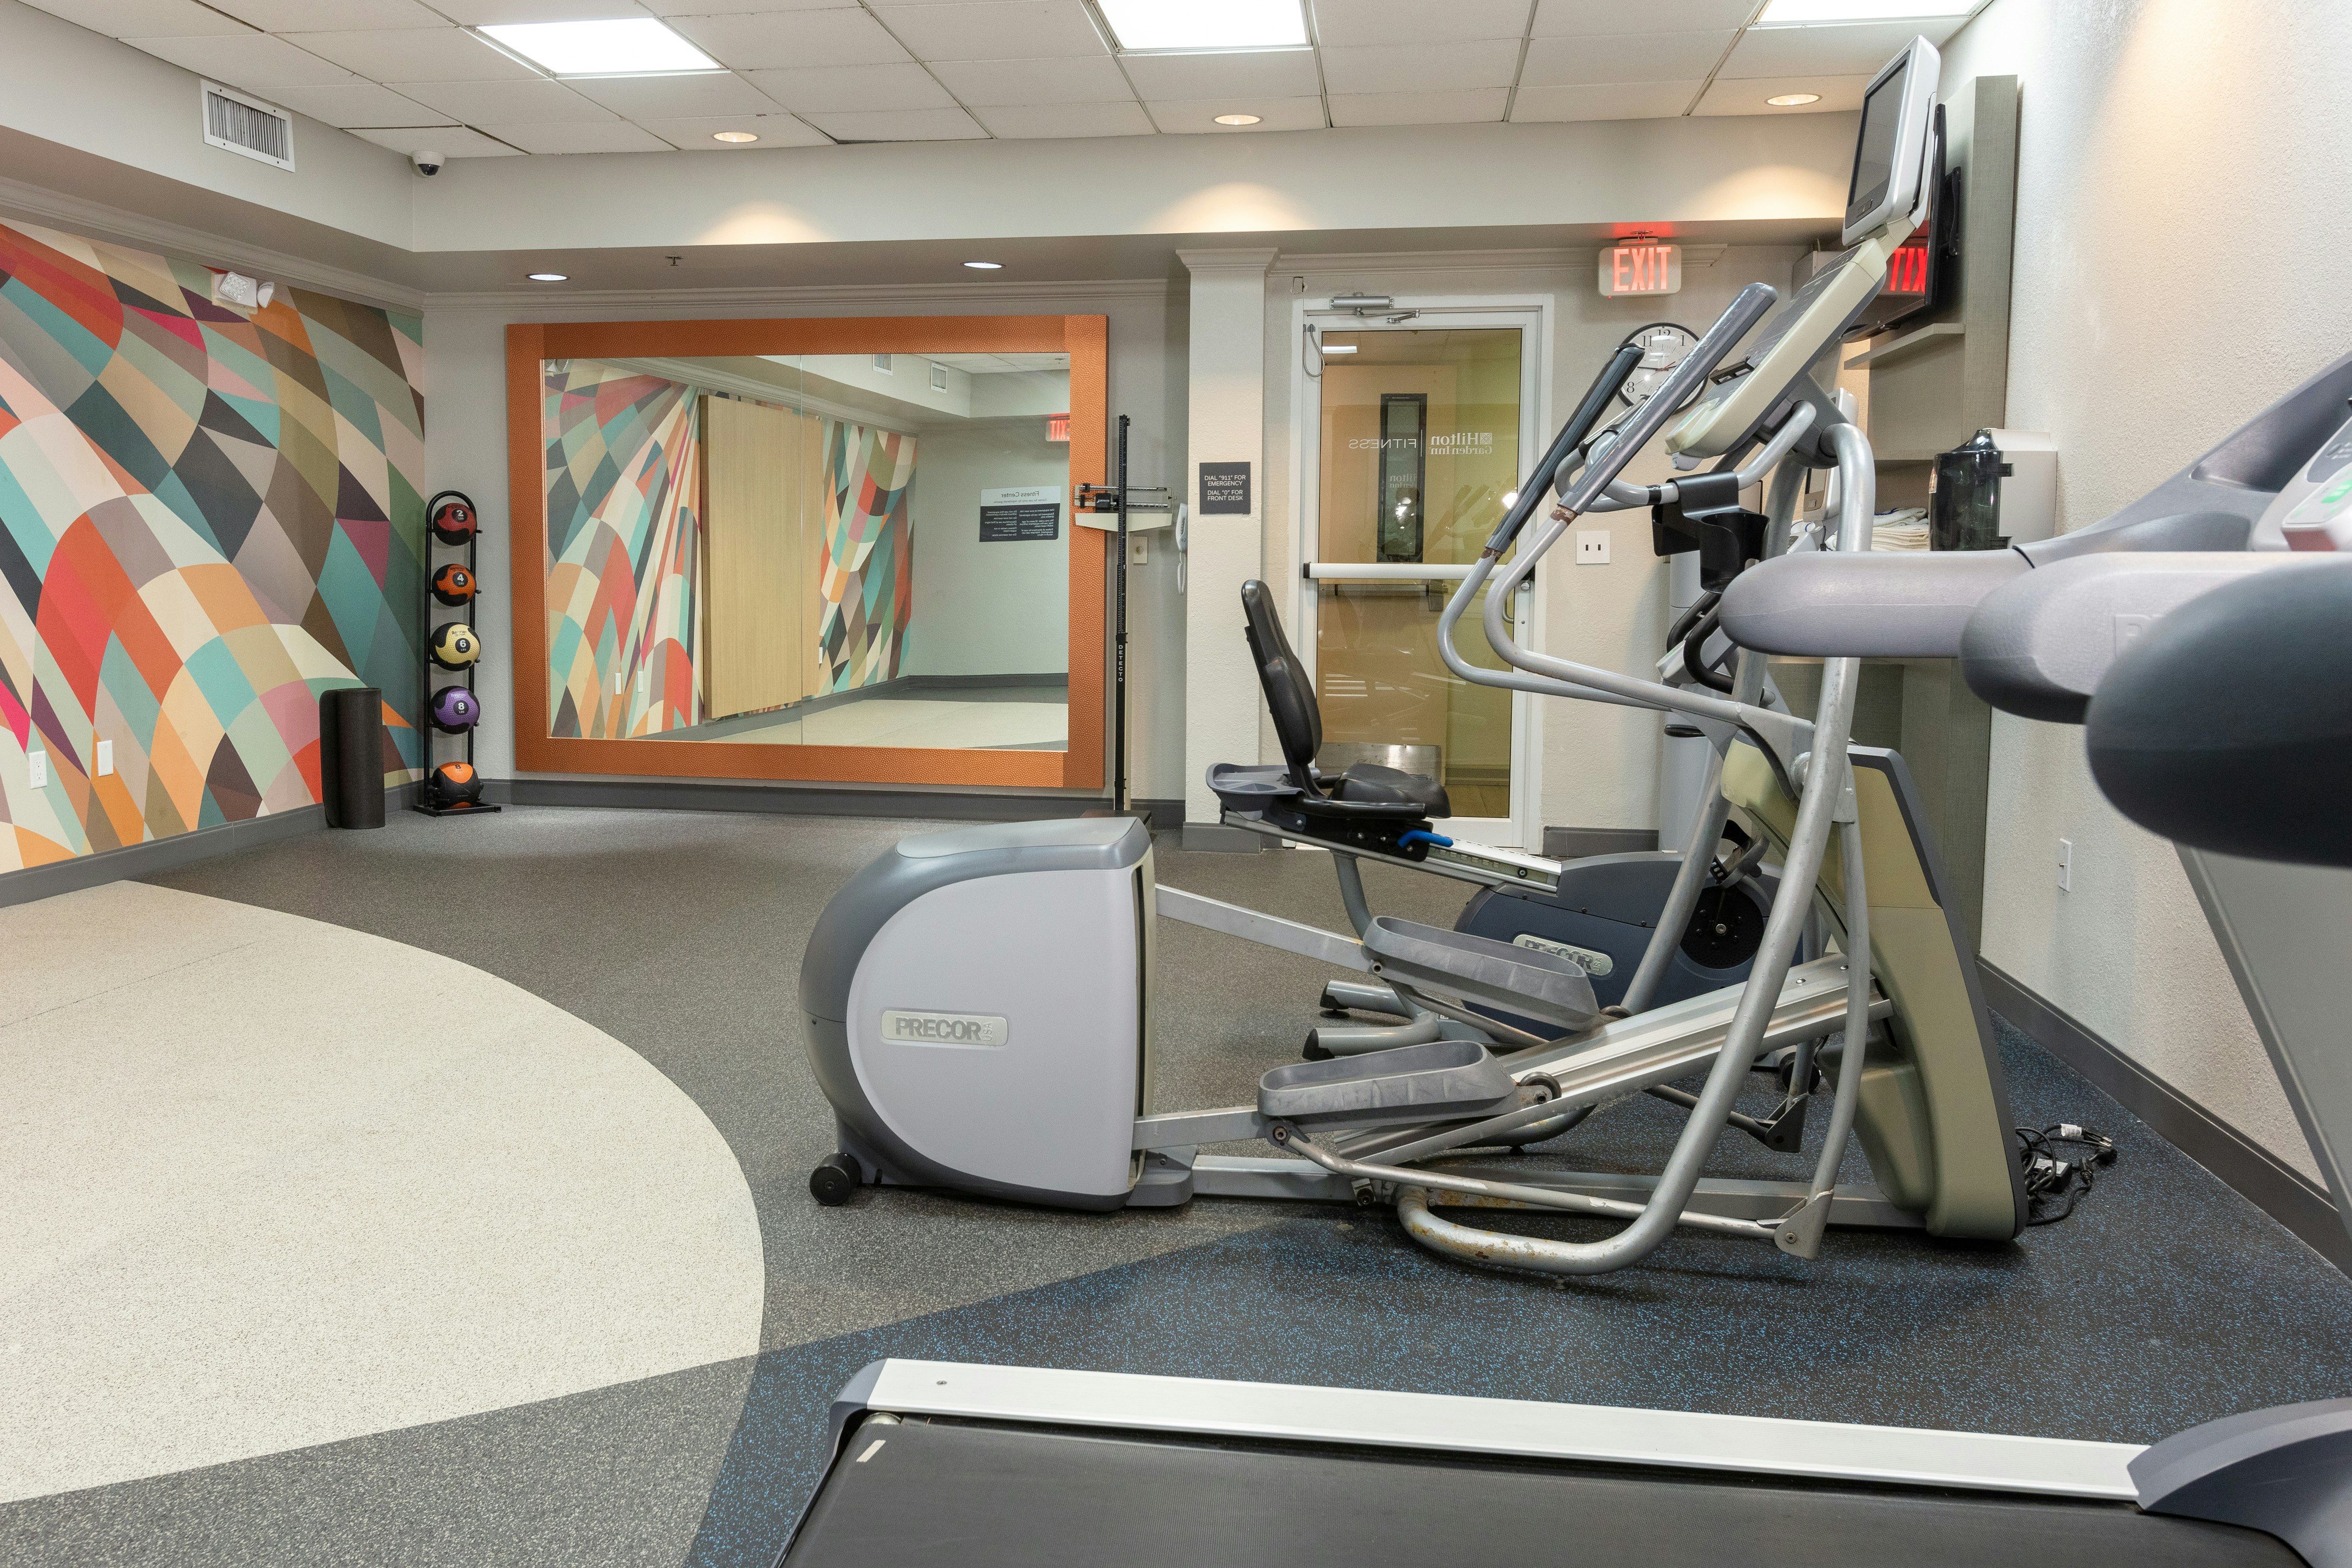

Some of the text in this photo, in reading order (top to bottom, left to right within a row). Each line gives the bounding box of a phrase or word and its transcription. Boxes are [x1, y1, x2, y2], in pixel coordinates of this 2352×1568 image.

[1613, 246, 1671, 292] EXIT
[1642, 336, 1653, 347] 11
[1680, 335, 1685, 346] 1
[1627, 382, 1634, 393] 8
[1593, 957, 1603, 972] USA
[895, 1016, 981, 1041] PRECOR
[983, 1022, 993, 1042] USA
